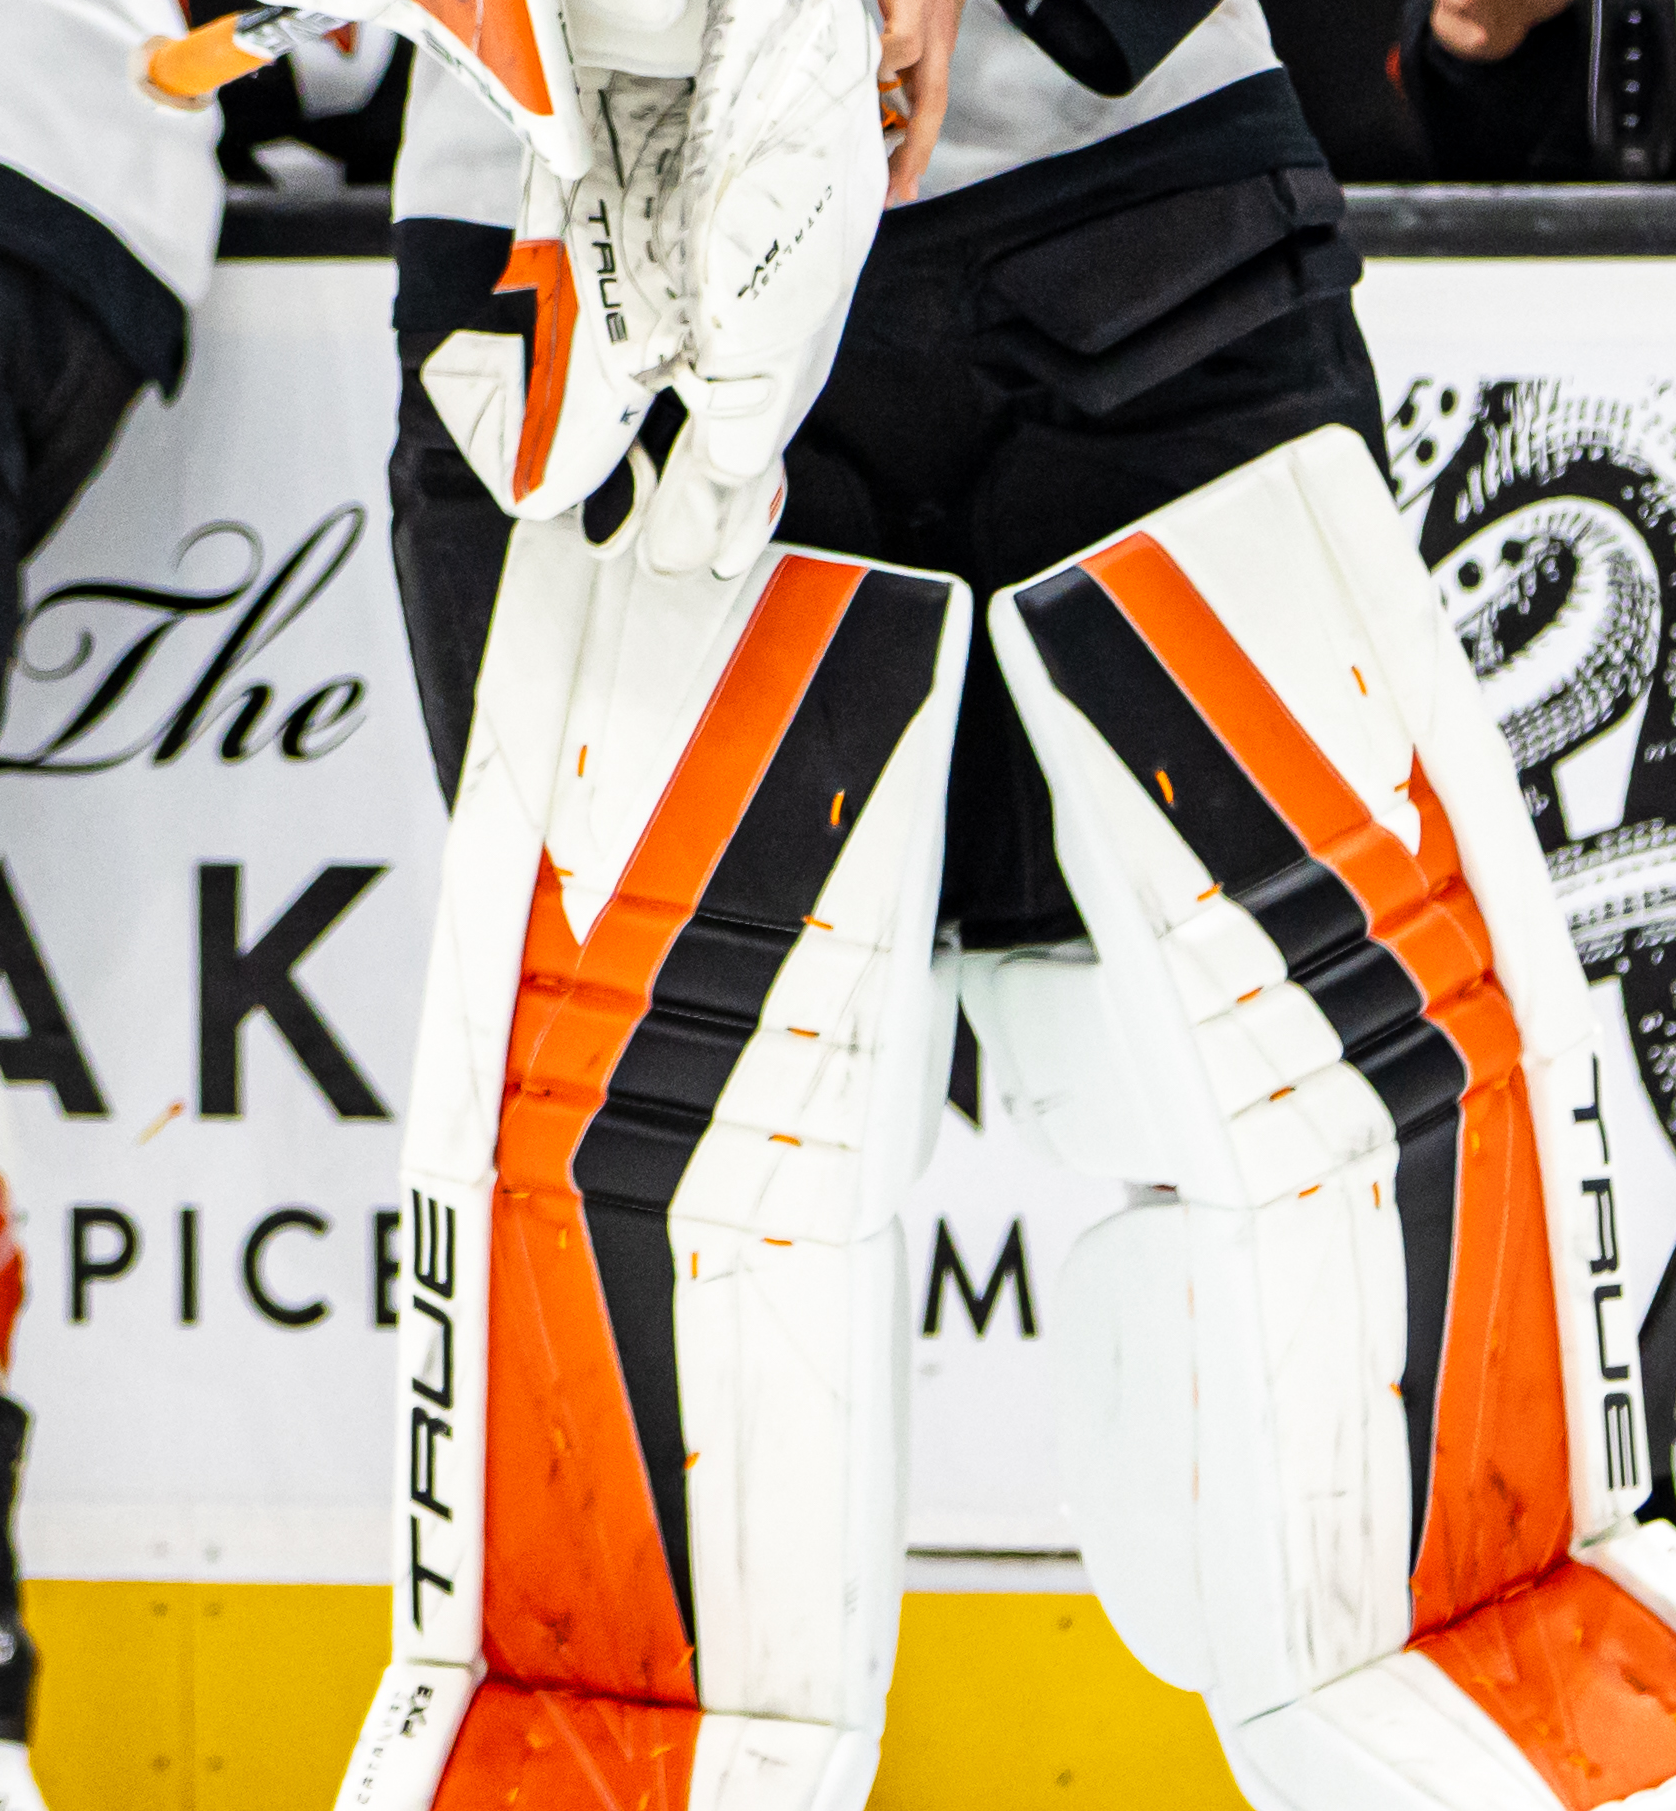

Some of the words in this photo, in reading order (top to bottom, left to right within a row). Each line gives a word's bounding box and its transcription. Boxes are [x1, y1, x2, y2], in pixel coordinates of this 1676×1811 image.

[588, 198, 628, 346] TRUE
[411, 1188, 457, 1632] TRUE
[1571, 1052, 1641, 1493] TRUE
